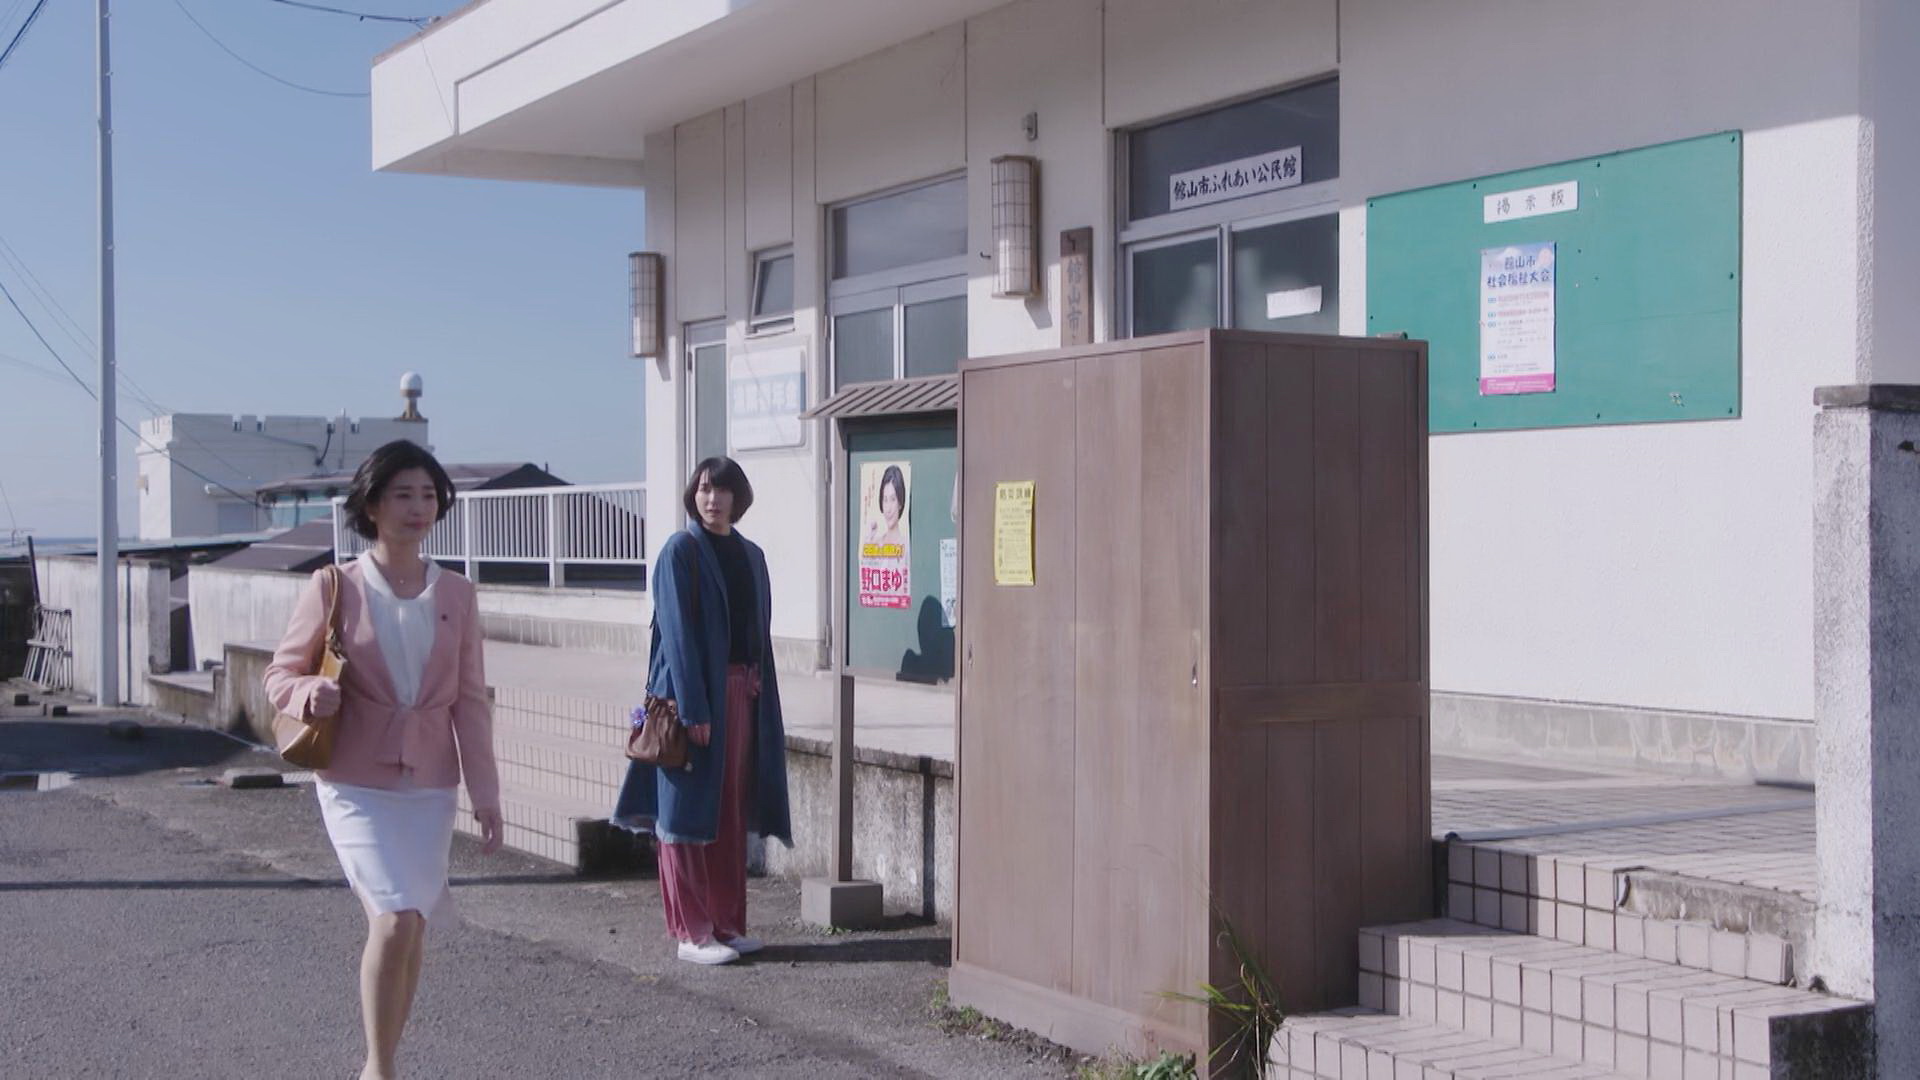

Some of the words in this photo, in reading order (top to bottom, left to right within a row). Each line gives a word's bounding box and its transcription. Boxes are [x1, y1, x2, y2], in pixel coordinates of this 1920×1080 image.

[1174, 155, 1297, 201] 館山市ふれあい公民館
[1486, 268, 1550, 288] 社会福祉大会
[1066, 257, 1083, 345] 館山市
[861, 567, 902, 592] 野口まゆ
